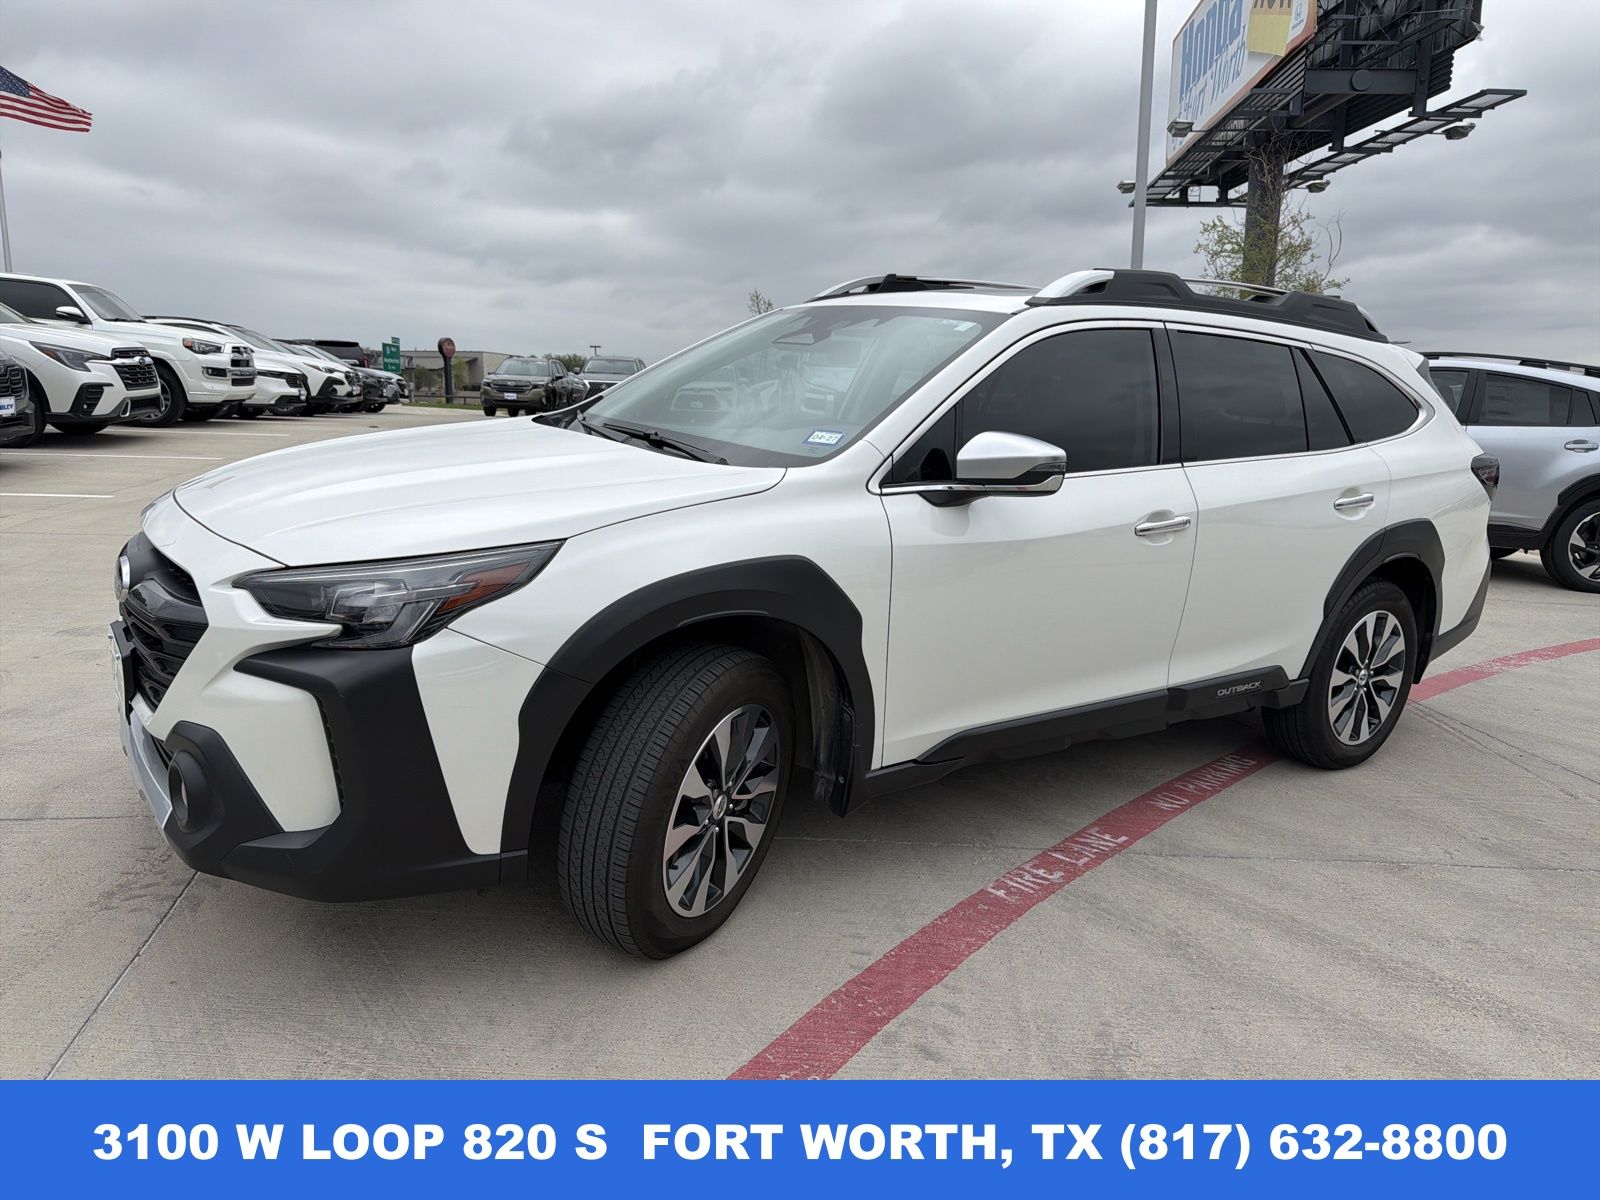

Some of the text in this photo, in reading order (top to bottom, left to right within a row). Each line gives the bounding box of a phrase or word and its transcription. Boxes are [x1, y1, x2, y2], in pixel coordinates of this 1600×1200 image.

[1217, 680, 1262, 696] OUTBACK
[985, 754, 1257, 904] FIRE LANE NO PARKING
